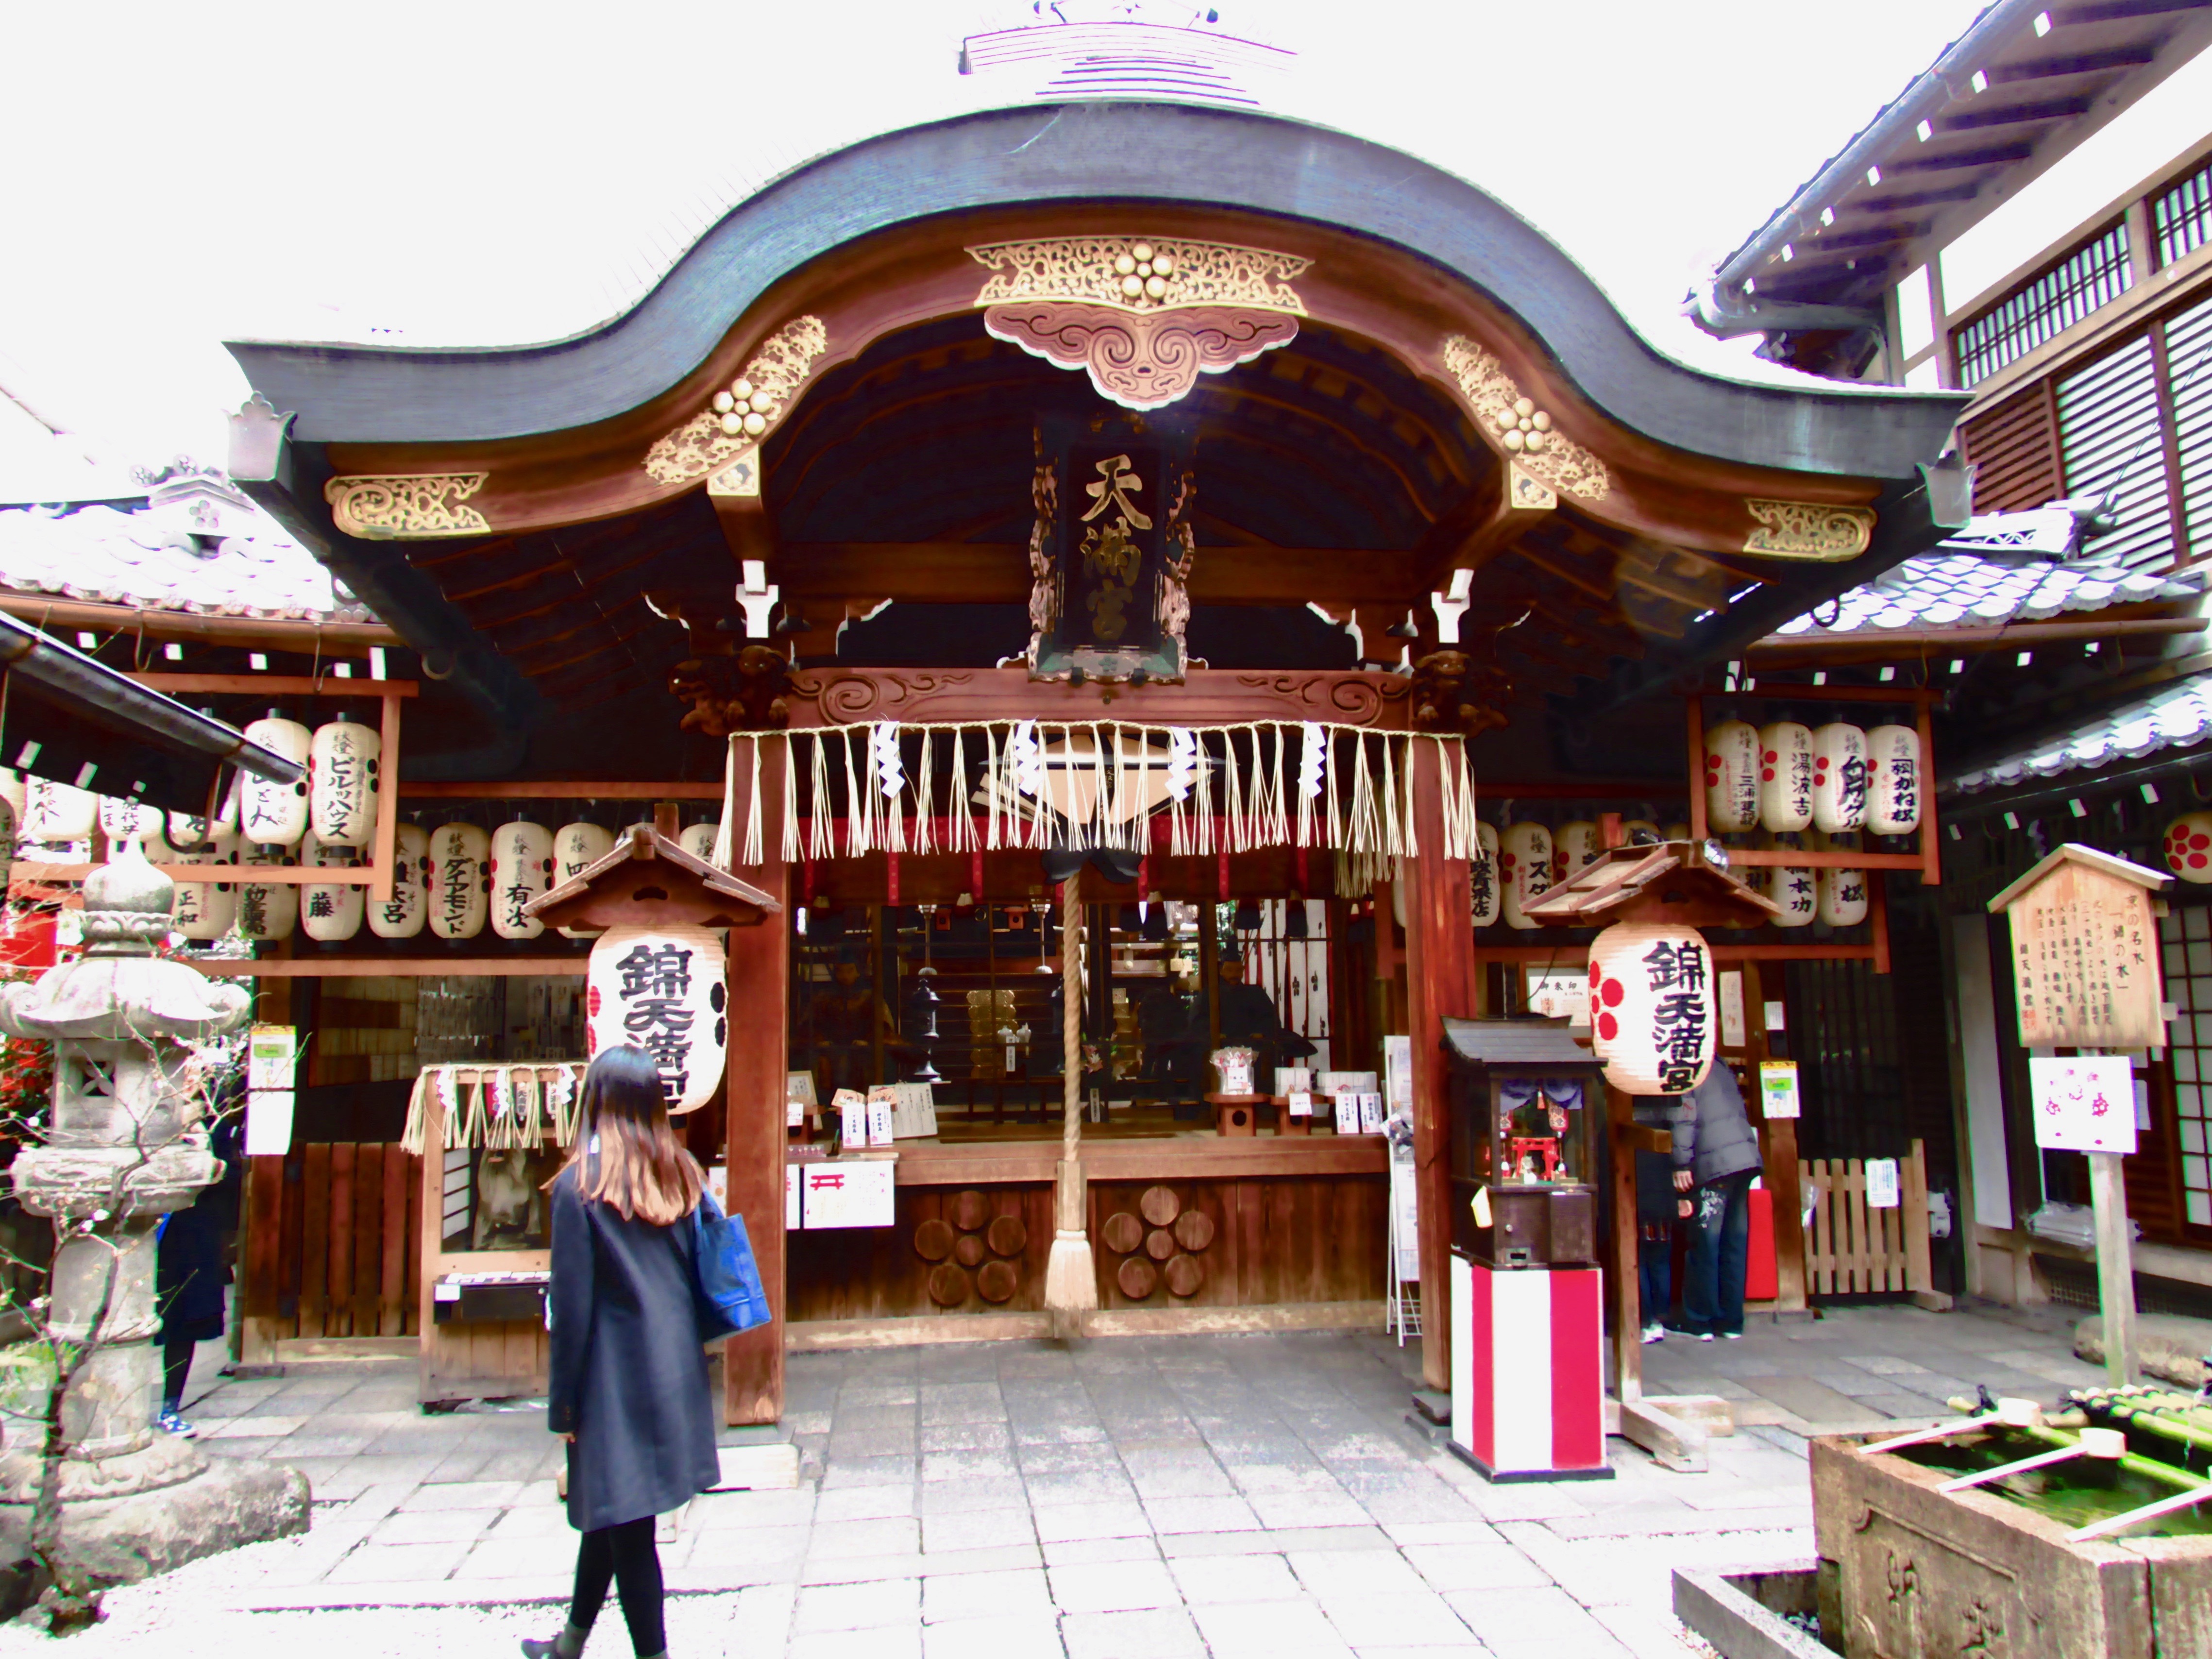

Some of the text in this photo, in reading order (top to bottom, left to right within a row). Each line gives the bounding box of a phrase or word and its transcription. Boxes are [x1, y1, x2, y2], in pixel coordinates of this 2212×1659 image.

[1792, 752, 1811, 816] 湯波吉
[505, 883, 534, 928] 有次
[1642, 940, 1706, 1092] 錦天満宮
